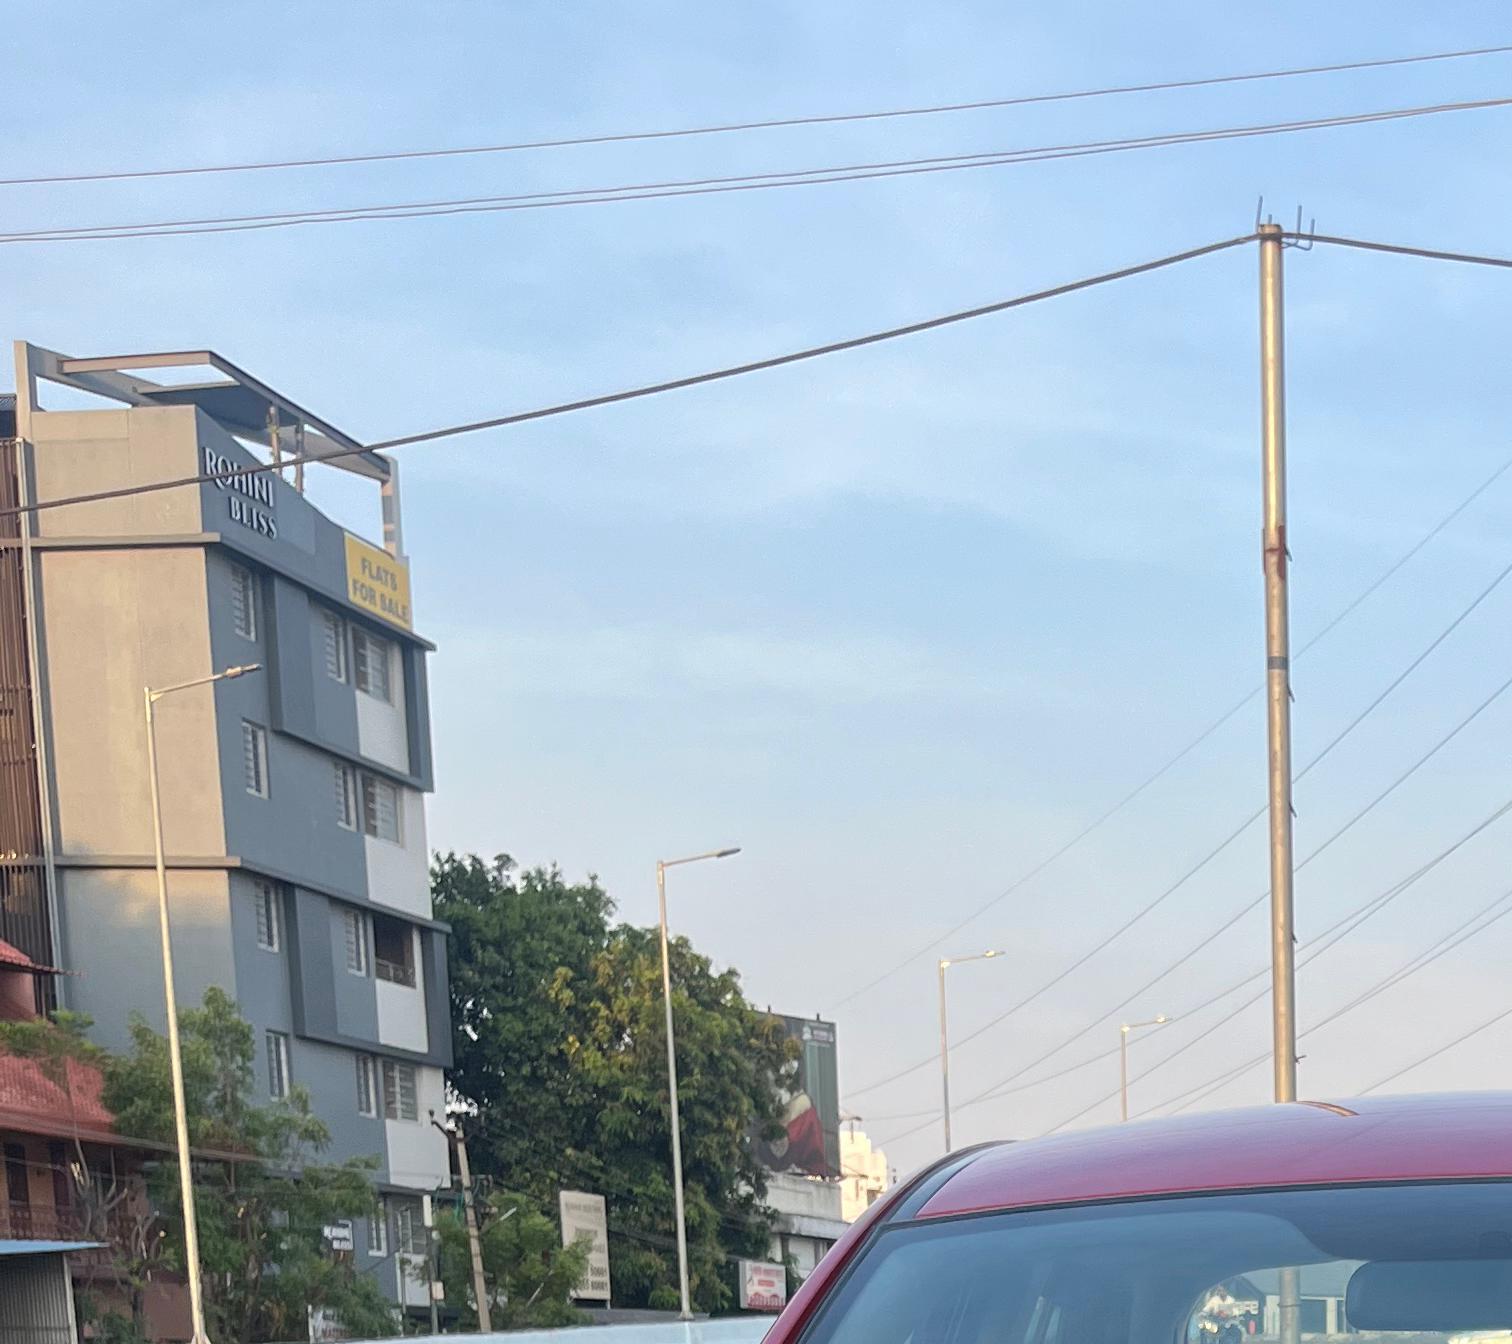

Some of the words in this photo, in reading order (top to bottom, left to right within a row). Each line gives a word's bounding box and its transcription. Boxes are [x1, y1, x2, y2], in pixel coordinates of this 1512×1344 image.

[204, 447, 274, 508] ROHINI
[229, 496, 278, 540] BLISS
[361, 557, 398, 592] FLATS
[352, 578, 377, 609] FOR
[380, 592, 410, 624] SALE
